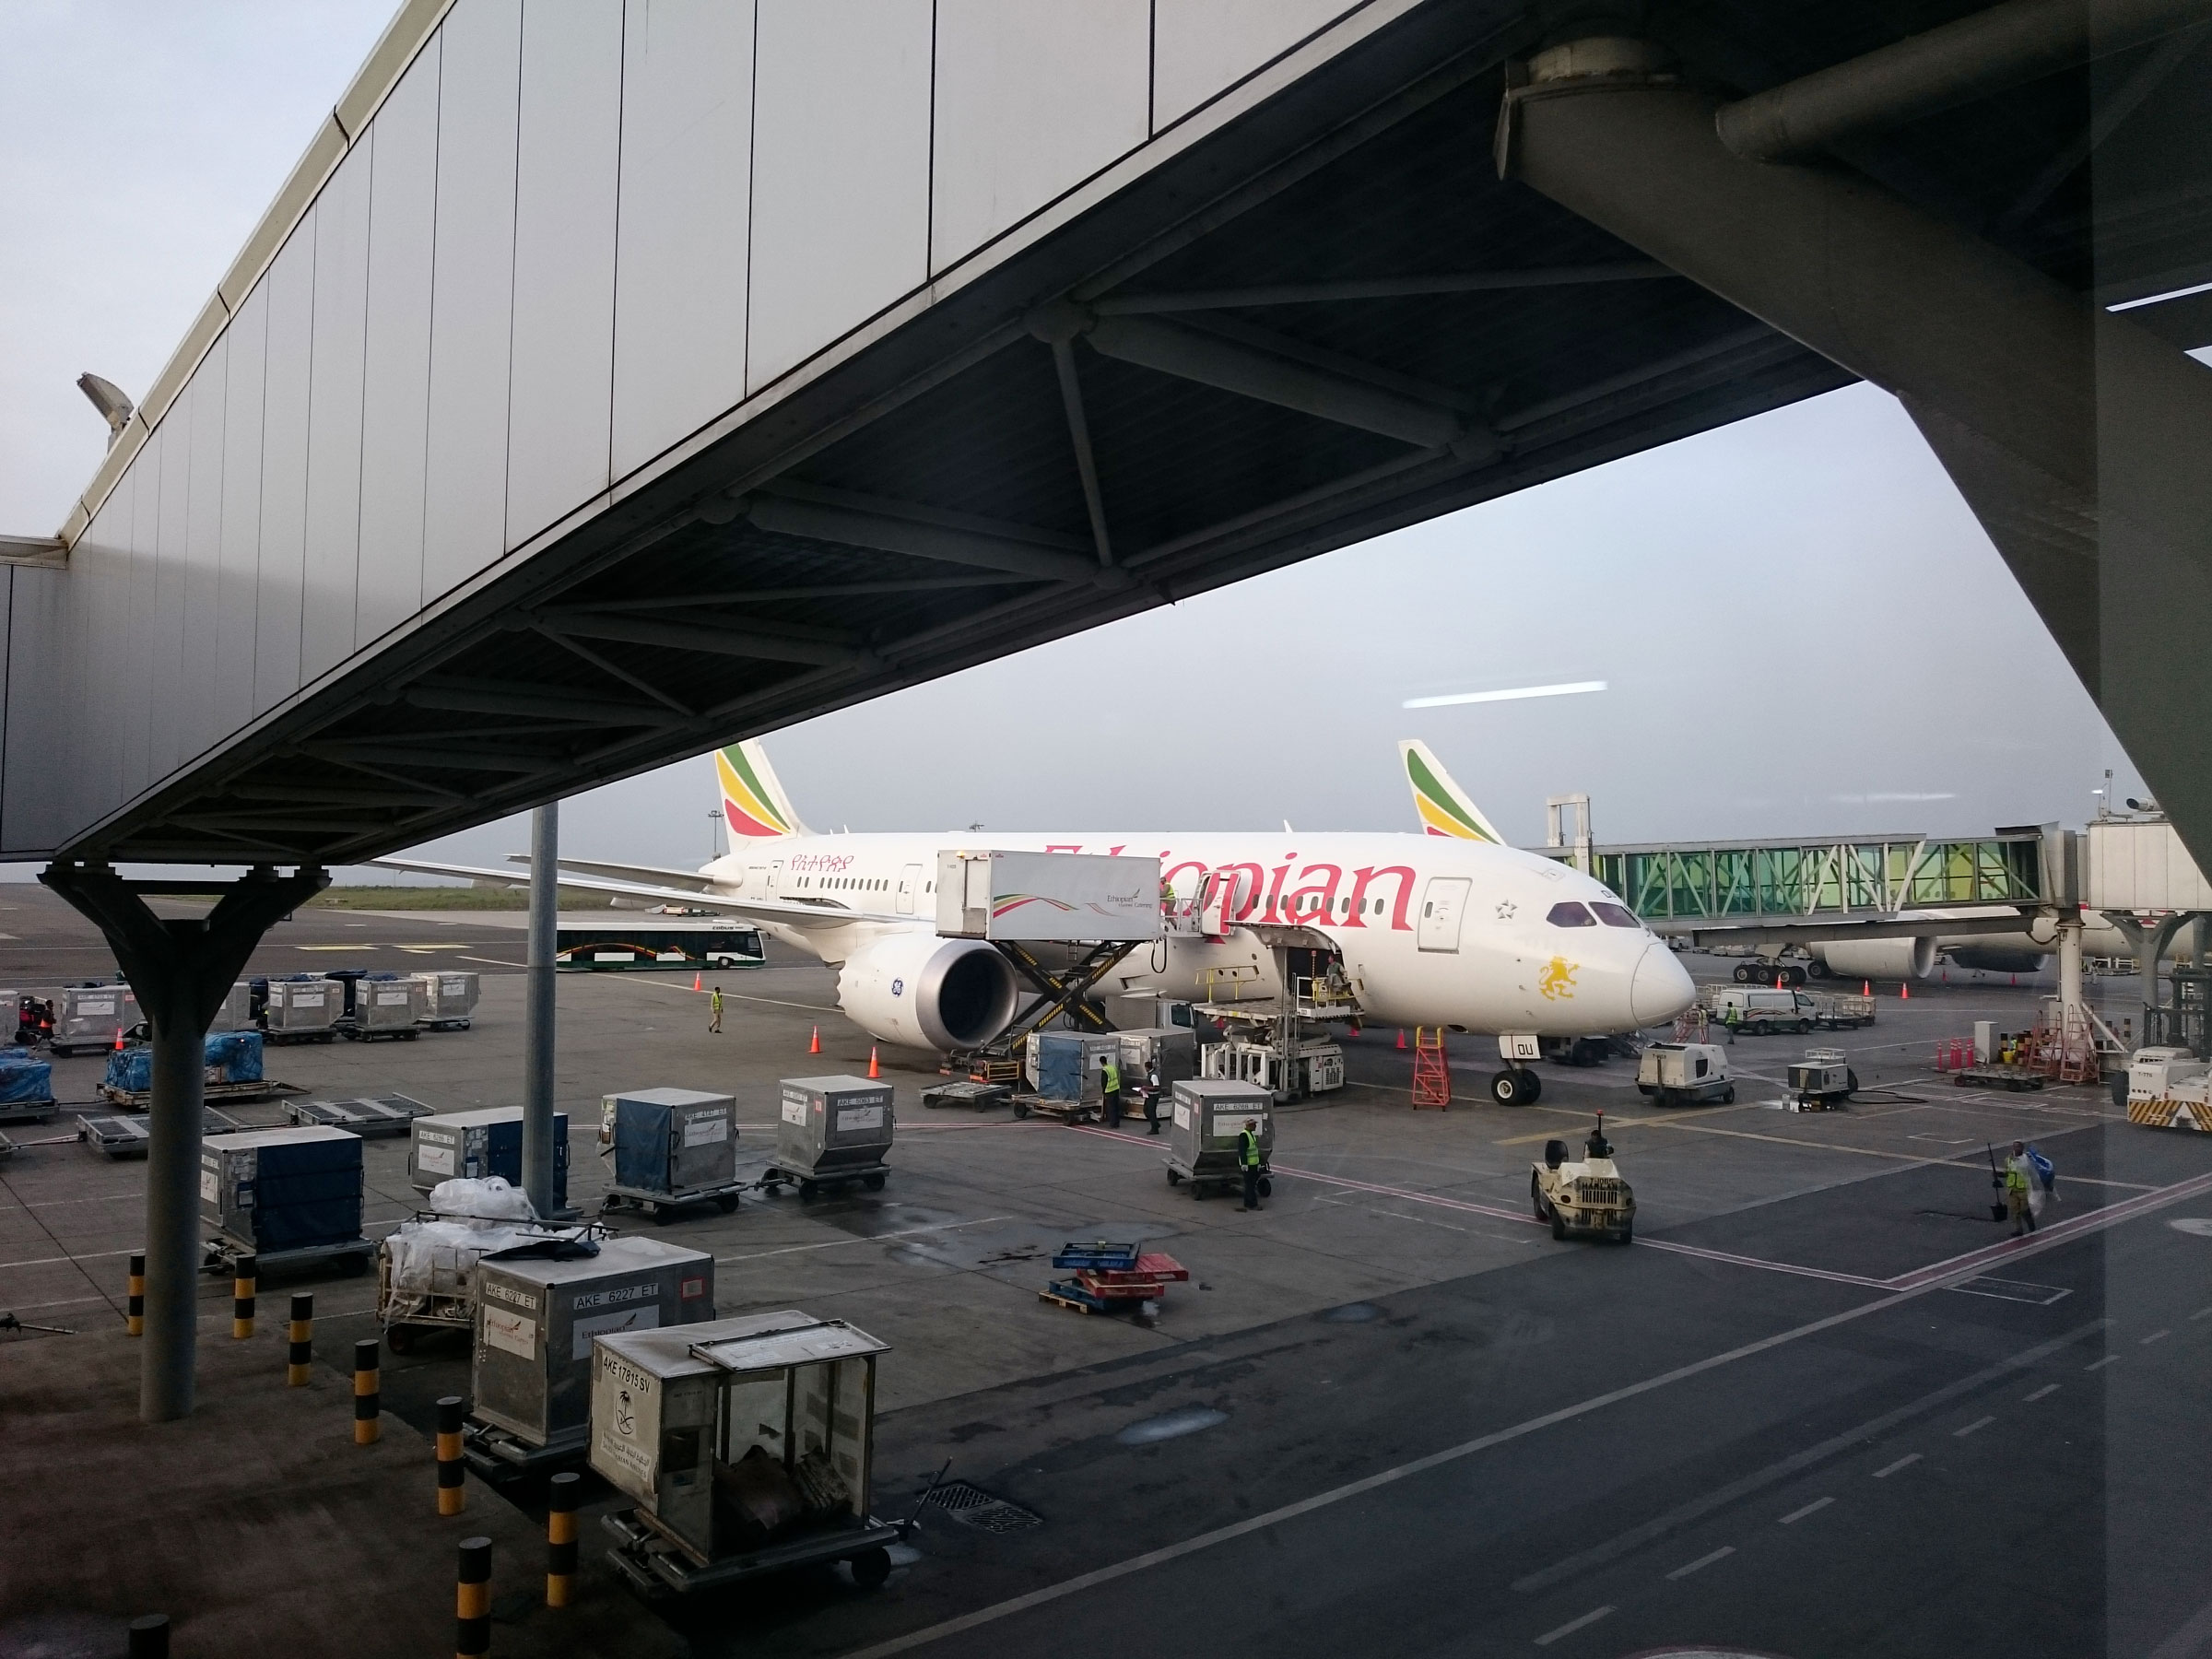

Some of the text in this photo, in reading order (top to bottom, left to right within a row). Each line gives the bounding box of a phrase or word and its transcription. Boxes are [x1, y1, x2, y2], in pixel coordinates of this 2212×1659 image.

[1517, 1043, 1534, 1055] OU
[488, 1283, 535, 1310] AKE 6227 ET
[576, 1284, 656, 1309] AKE 6227 ET
[604, 1357, 651, 1393] AKE 17815 SV
